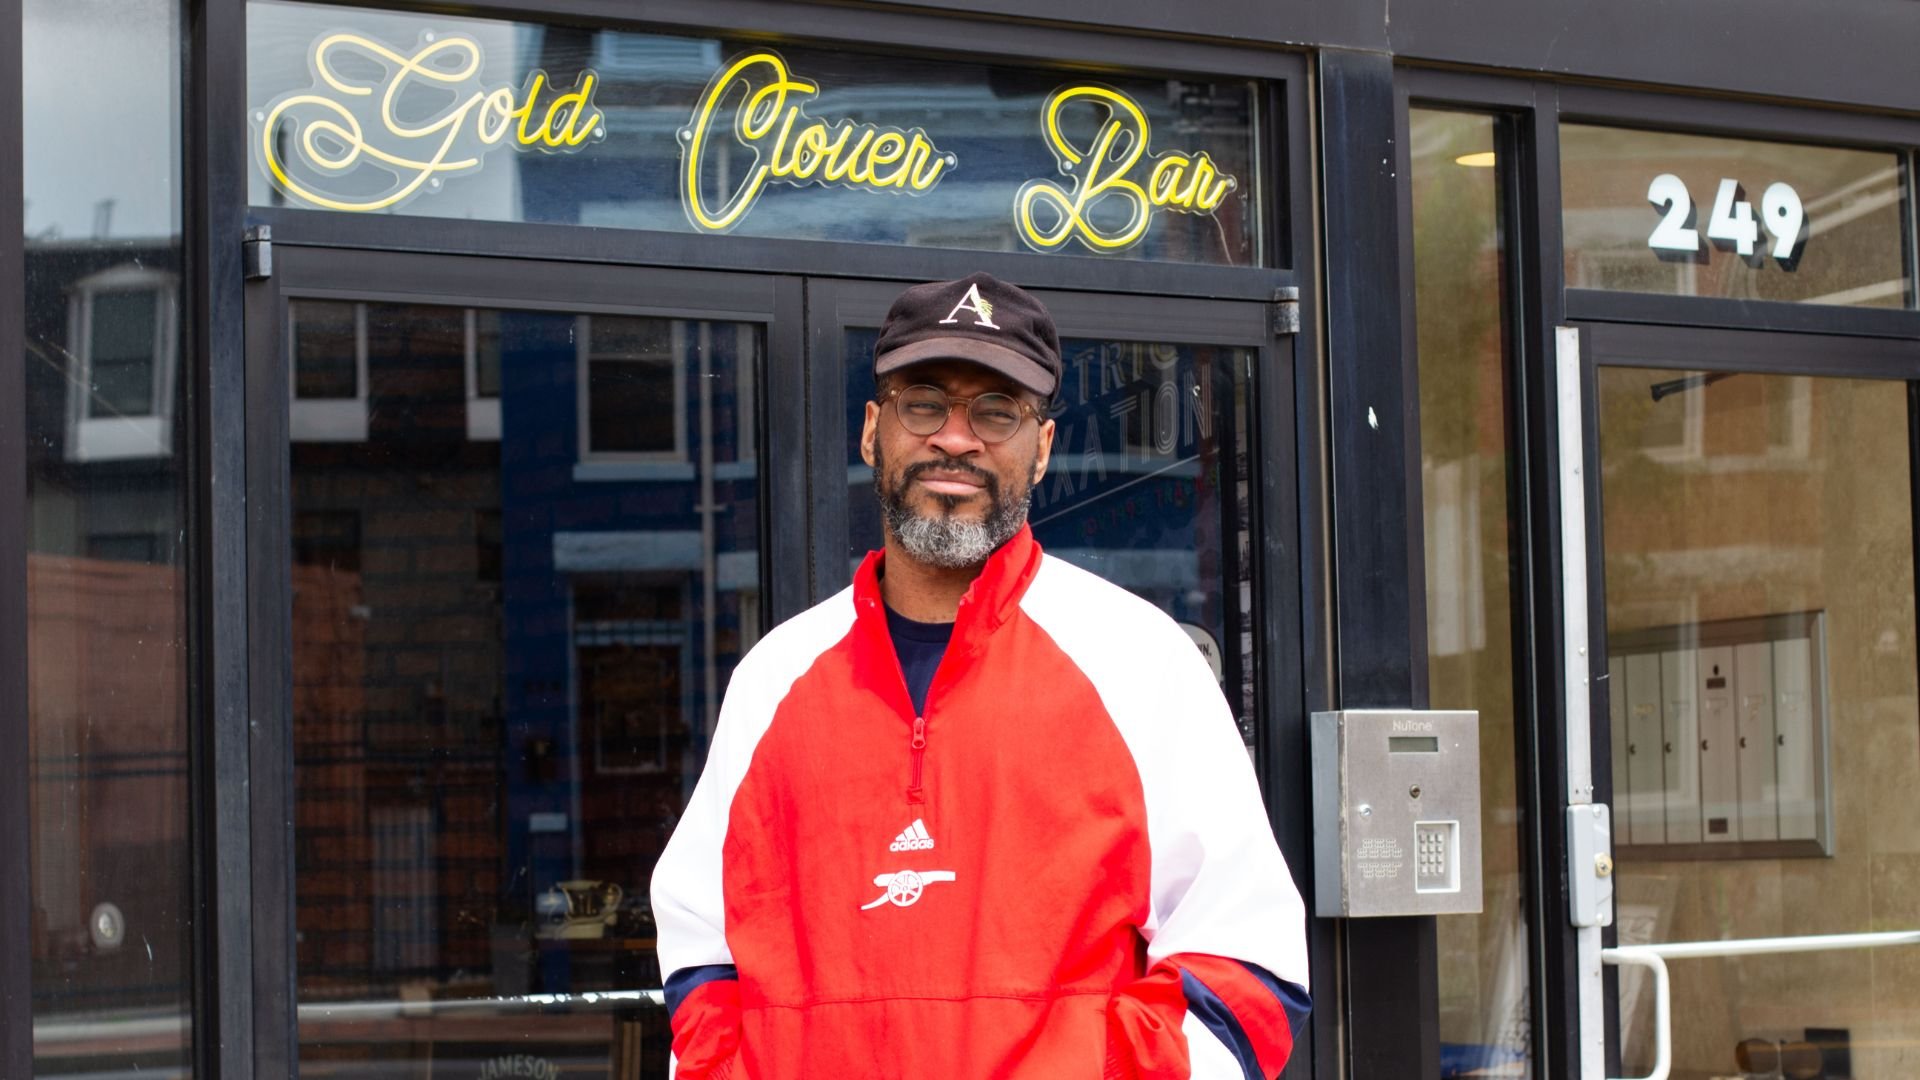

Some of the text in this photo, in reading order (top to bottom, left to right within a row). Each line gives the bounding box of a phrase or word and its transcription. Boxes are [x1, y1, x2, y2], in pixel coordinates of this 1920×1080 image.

[263, 33, 1228, 248] Gold Clover Bar
[1647, 173, 1804, 260] 249
[939, 283, 1000, 330] A
[1392, 719, 1433, 732] NuTone
[889, 838, 934, 852] adidas
[478, 1053, 561, 1080] JAMESON
